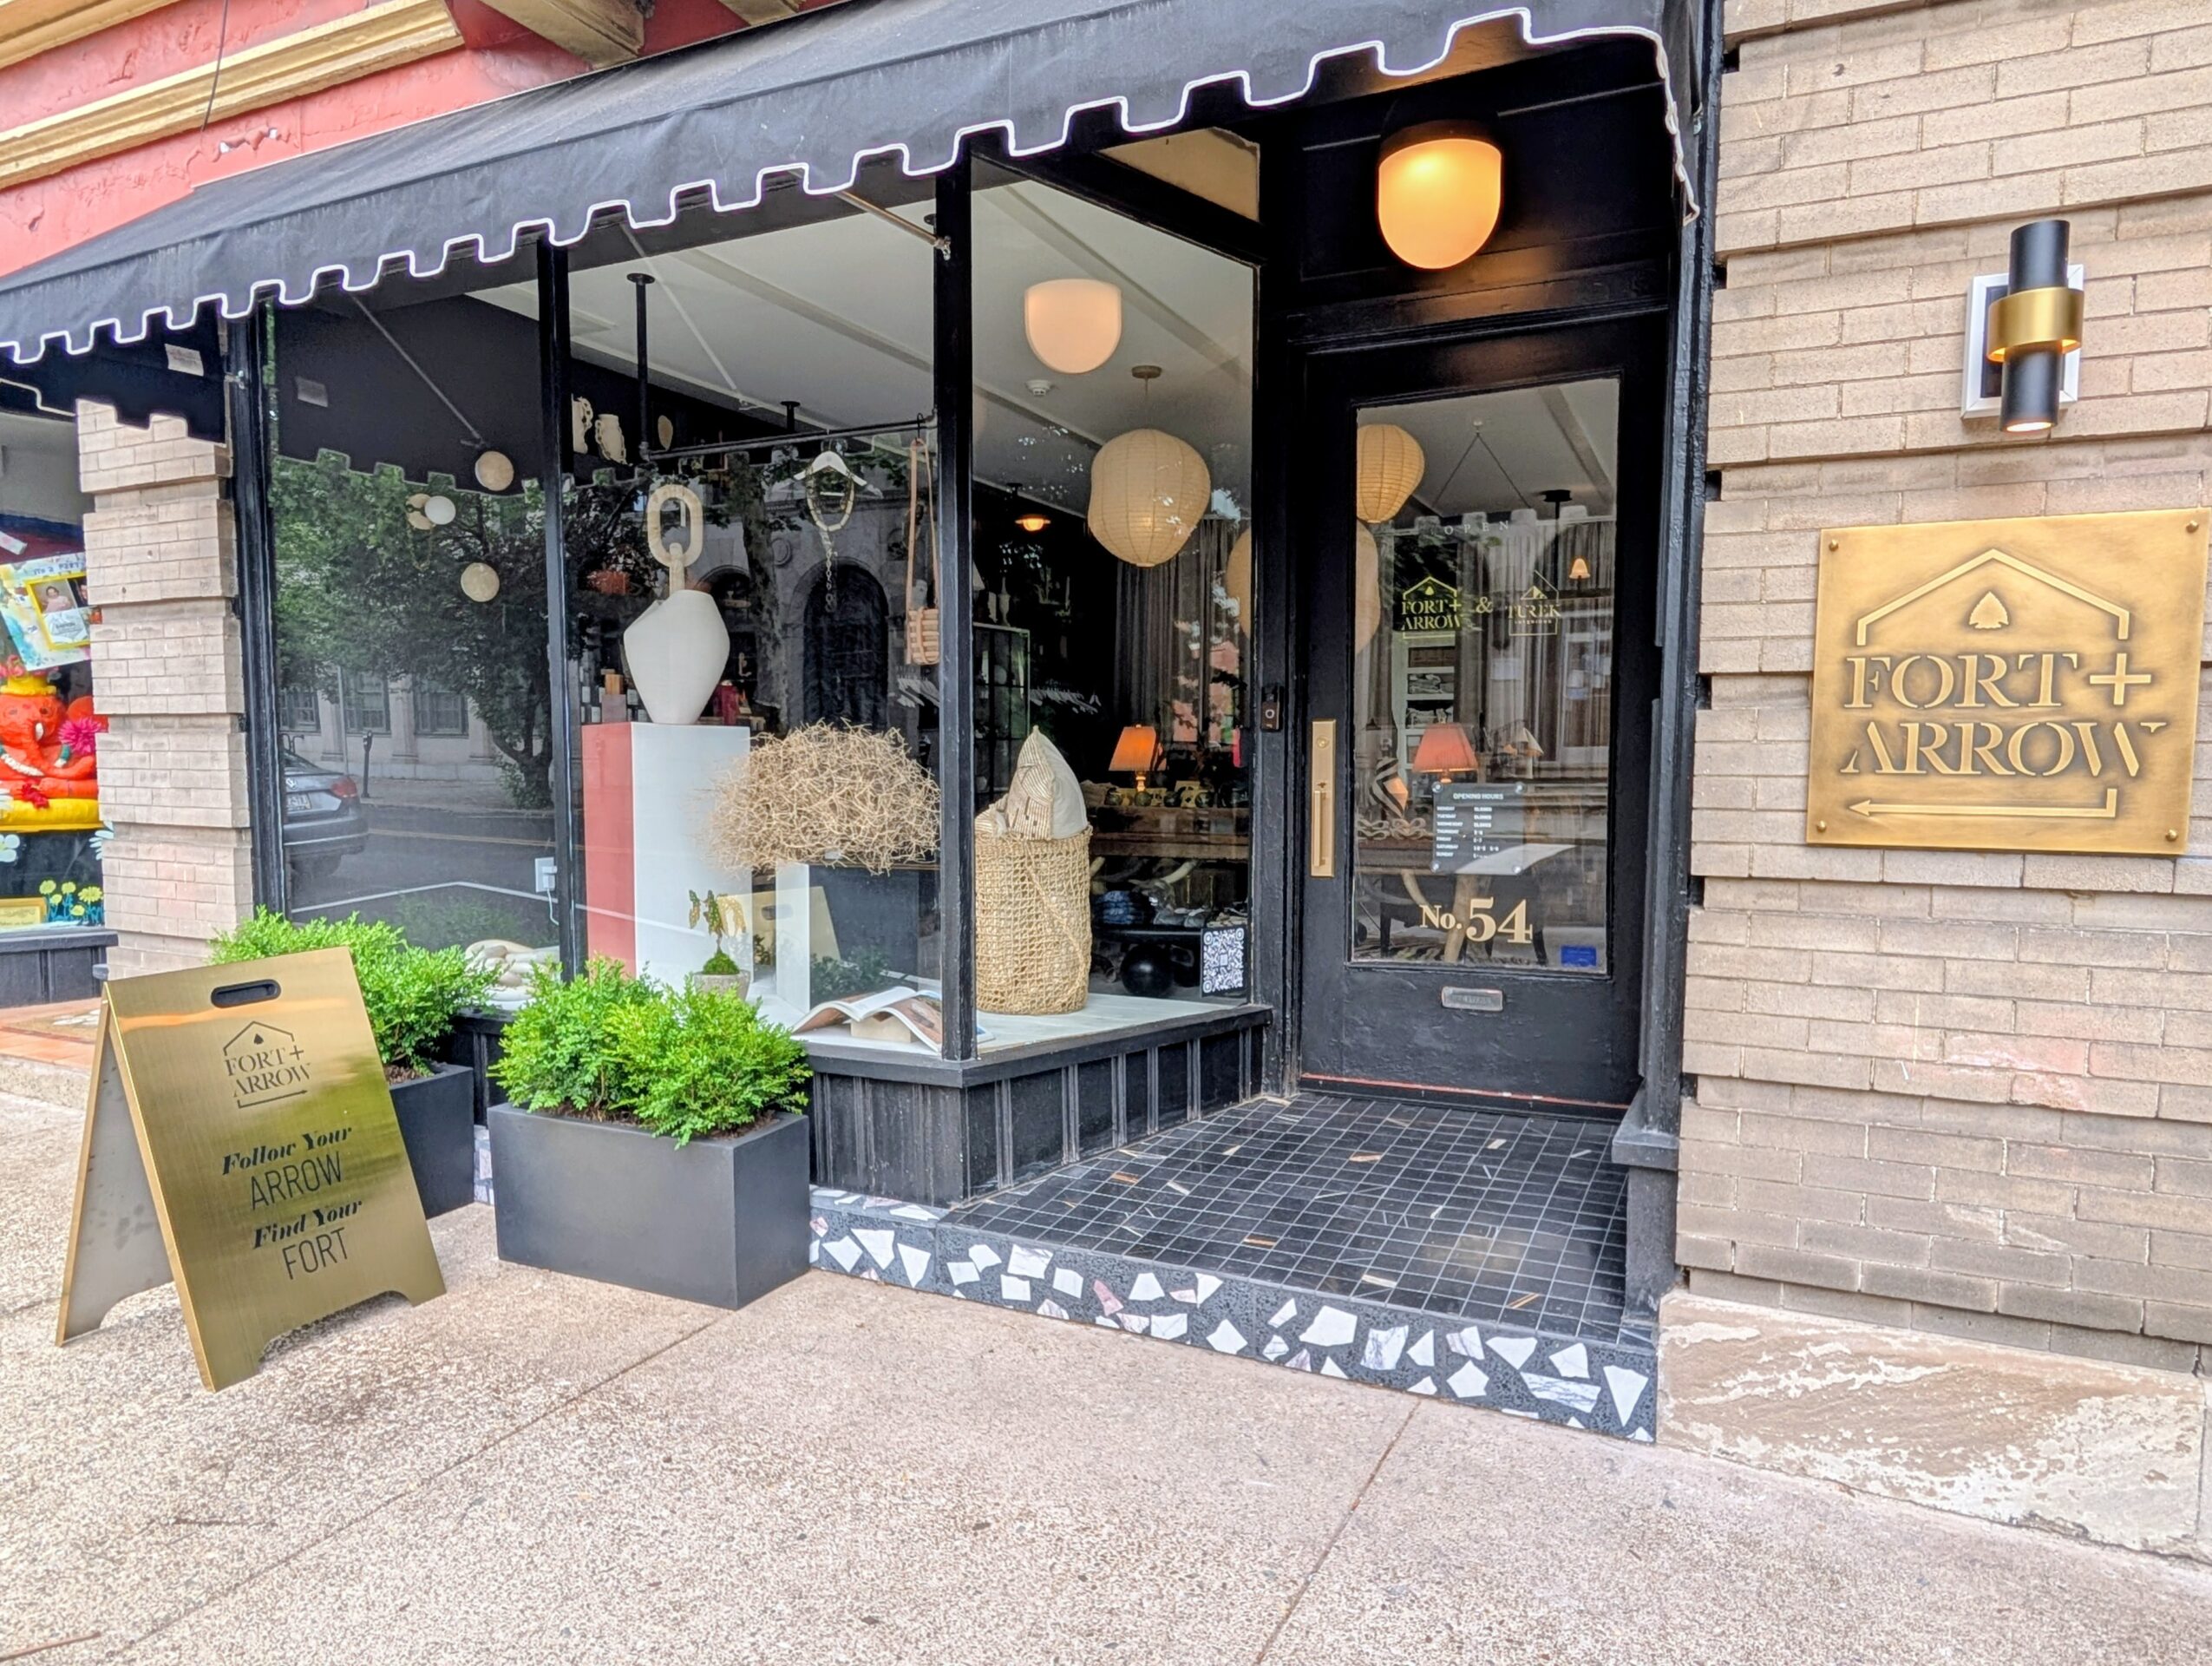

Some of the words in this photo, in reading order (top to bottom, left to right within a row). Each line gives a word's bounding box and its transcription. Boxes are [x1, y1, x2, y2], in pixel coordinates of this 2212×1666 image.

[1401, 614, 1463, 631] ARROW
[1402, 600, 1448, 614] FORT
[1843, 653, 2078, 710] FORT
[1840, 720, 2168, 777] ARROW
[232, 1062, 311, 1098] ARROW
[222, 1143, 297, 1175] Follow
[301, 1127, 352, 1151] Your
[251, 1151, 342, 1210] ARROW
[252, 1214, 306, 1250] Find
[312, 1200, 363, 1226] Your
[282, 1226, 348, 1281] FORT
